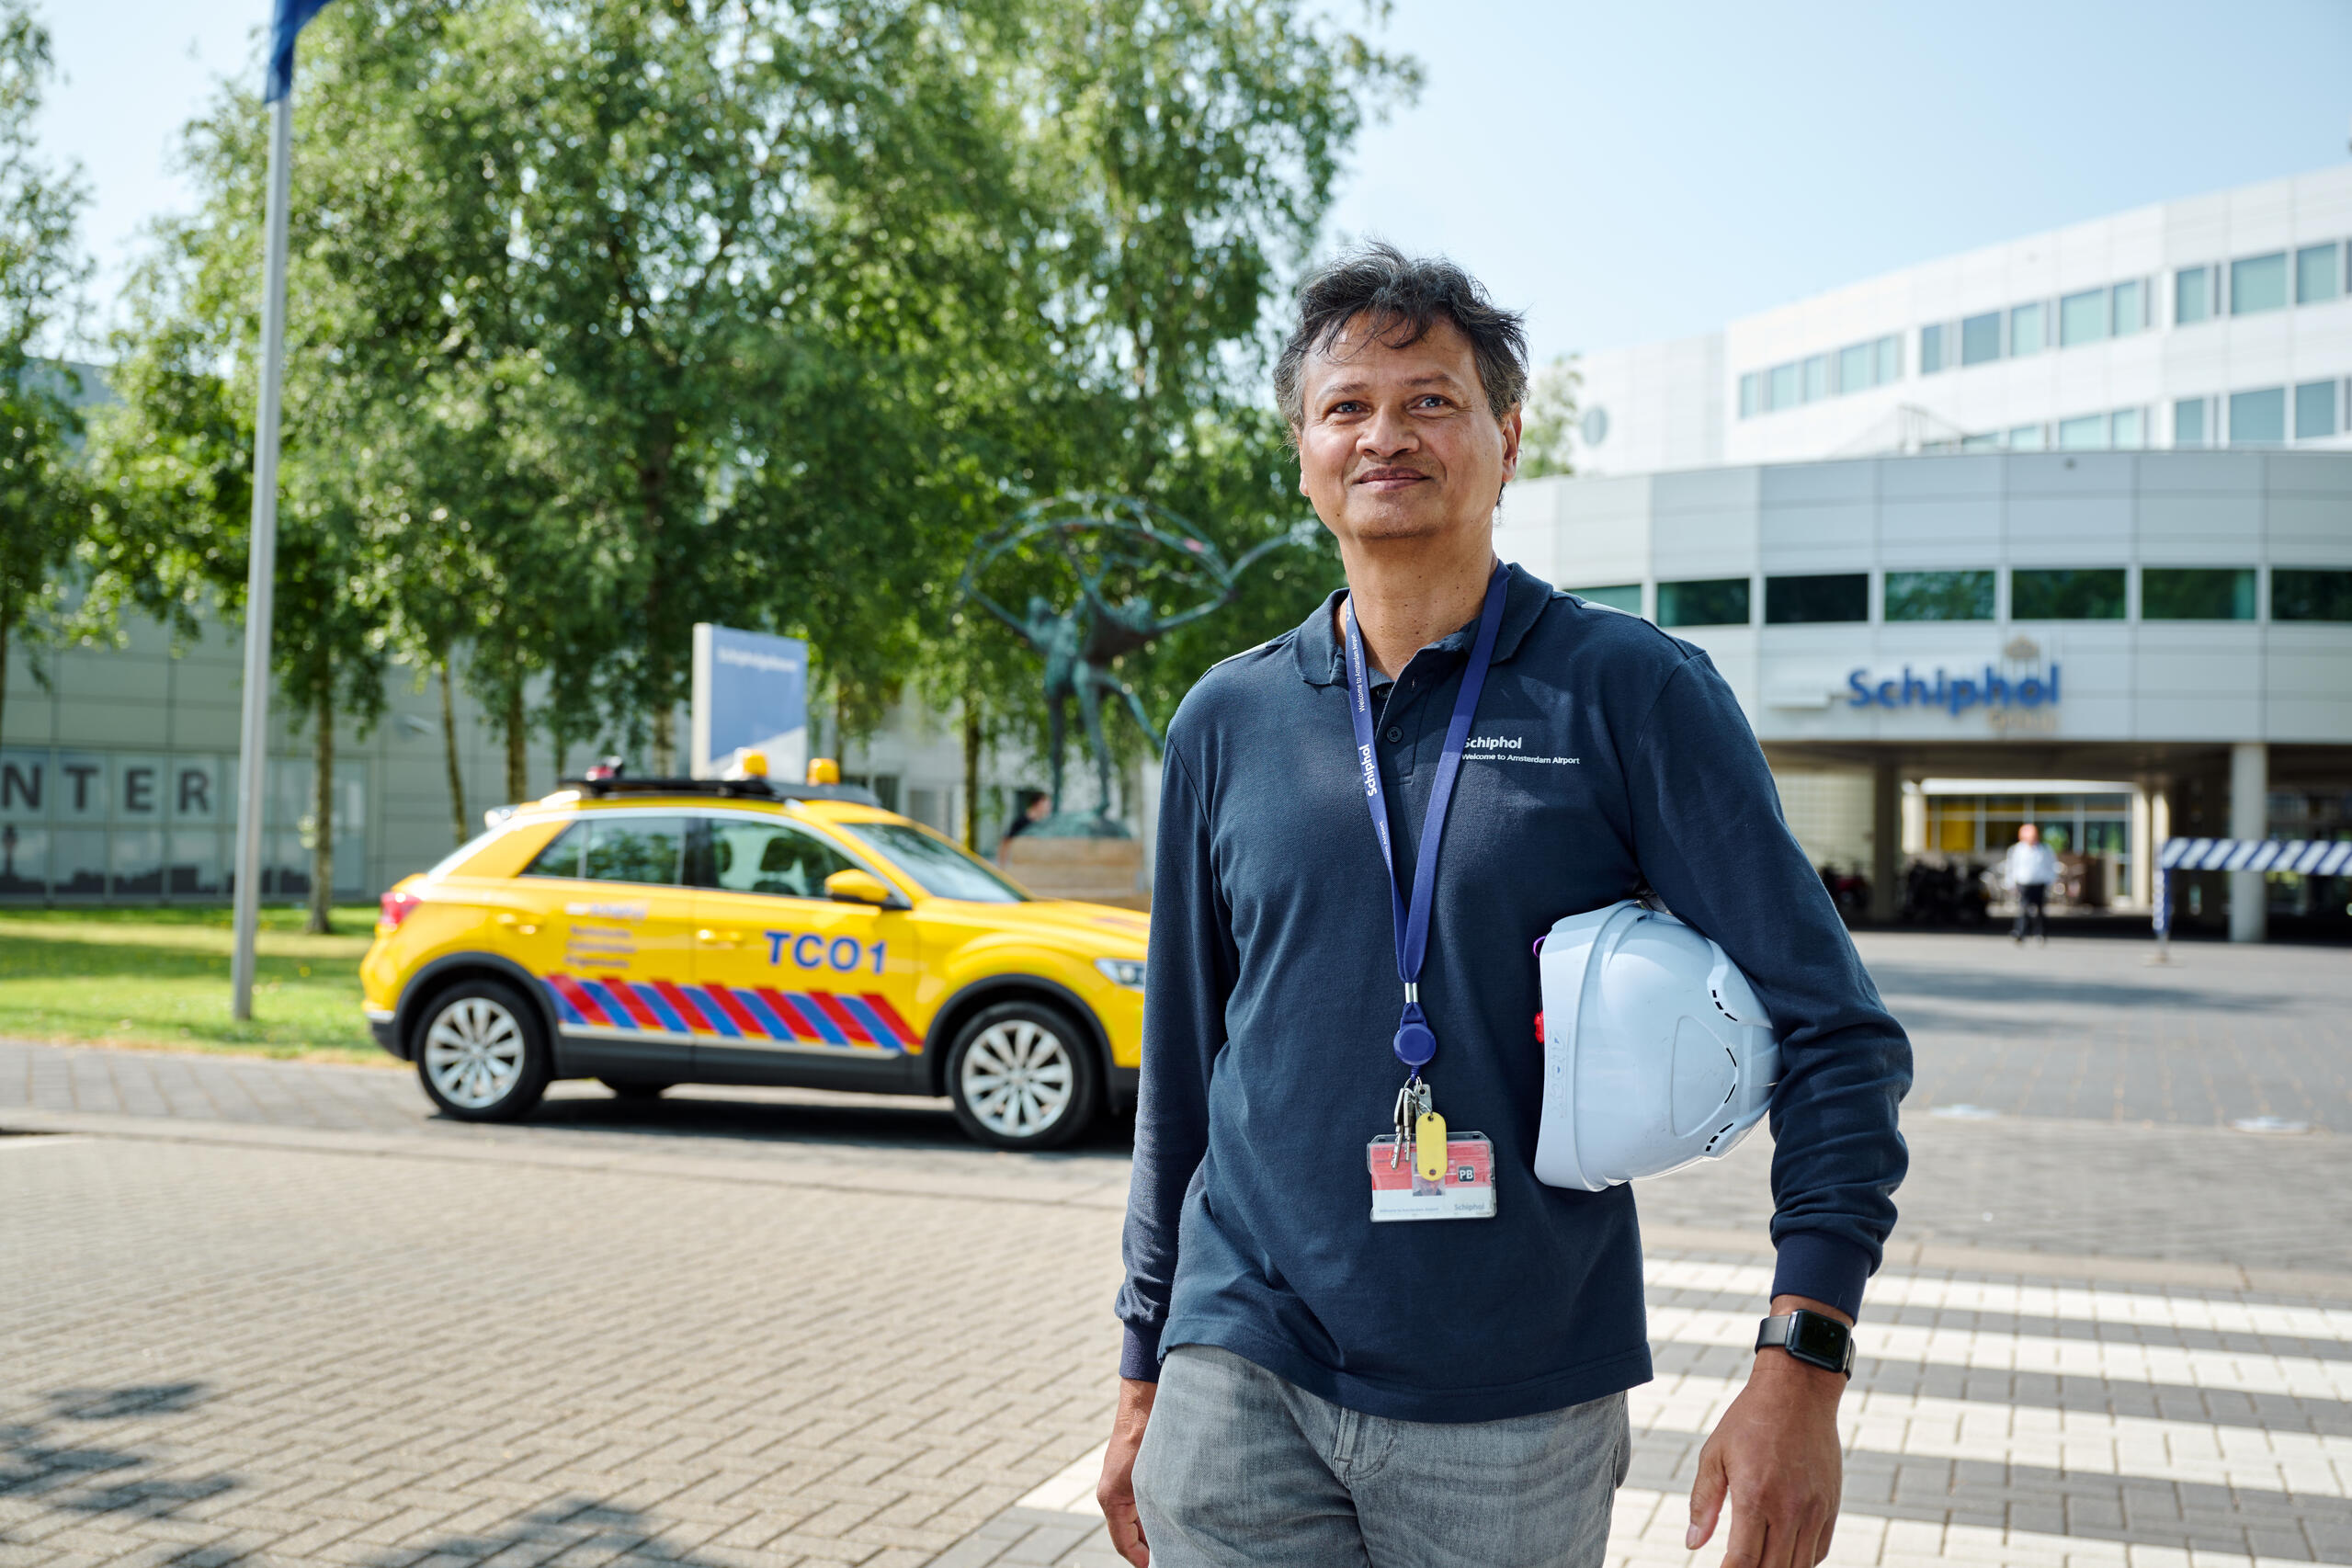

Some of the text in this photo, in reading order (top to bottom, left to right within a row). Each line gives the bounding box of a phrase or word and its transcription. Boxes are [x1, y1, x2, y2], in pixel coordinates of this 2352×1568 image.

[1353, 649, 1361, 677] Amsterdam
[1356, 676, 1362, 685] to
[1849, 662, 2060, 717] Schiphol
[1358, 685, 1366, 712] Welcome
[1358, 744, 1378, 798] Schiphol
[1507, 755, 1551, 764] Amsterdam
[1552, 756, 1580, 765] Airport
[2, 763, 211, 813] NTER
[1460, 1170, 1473, 1179] PB
